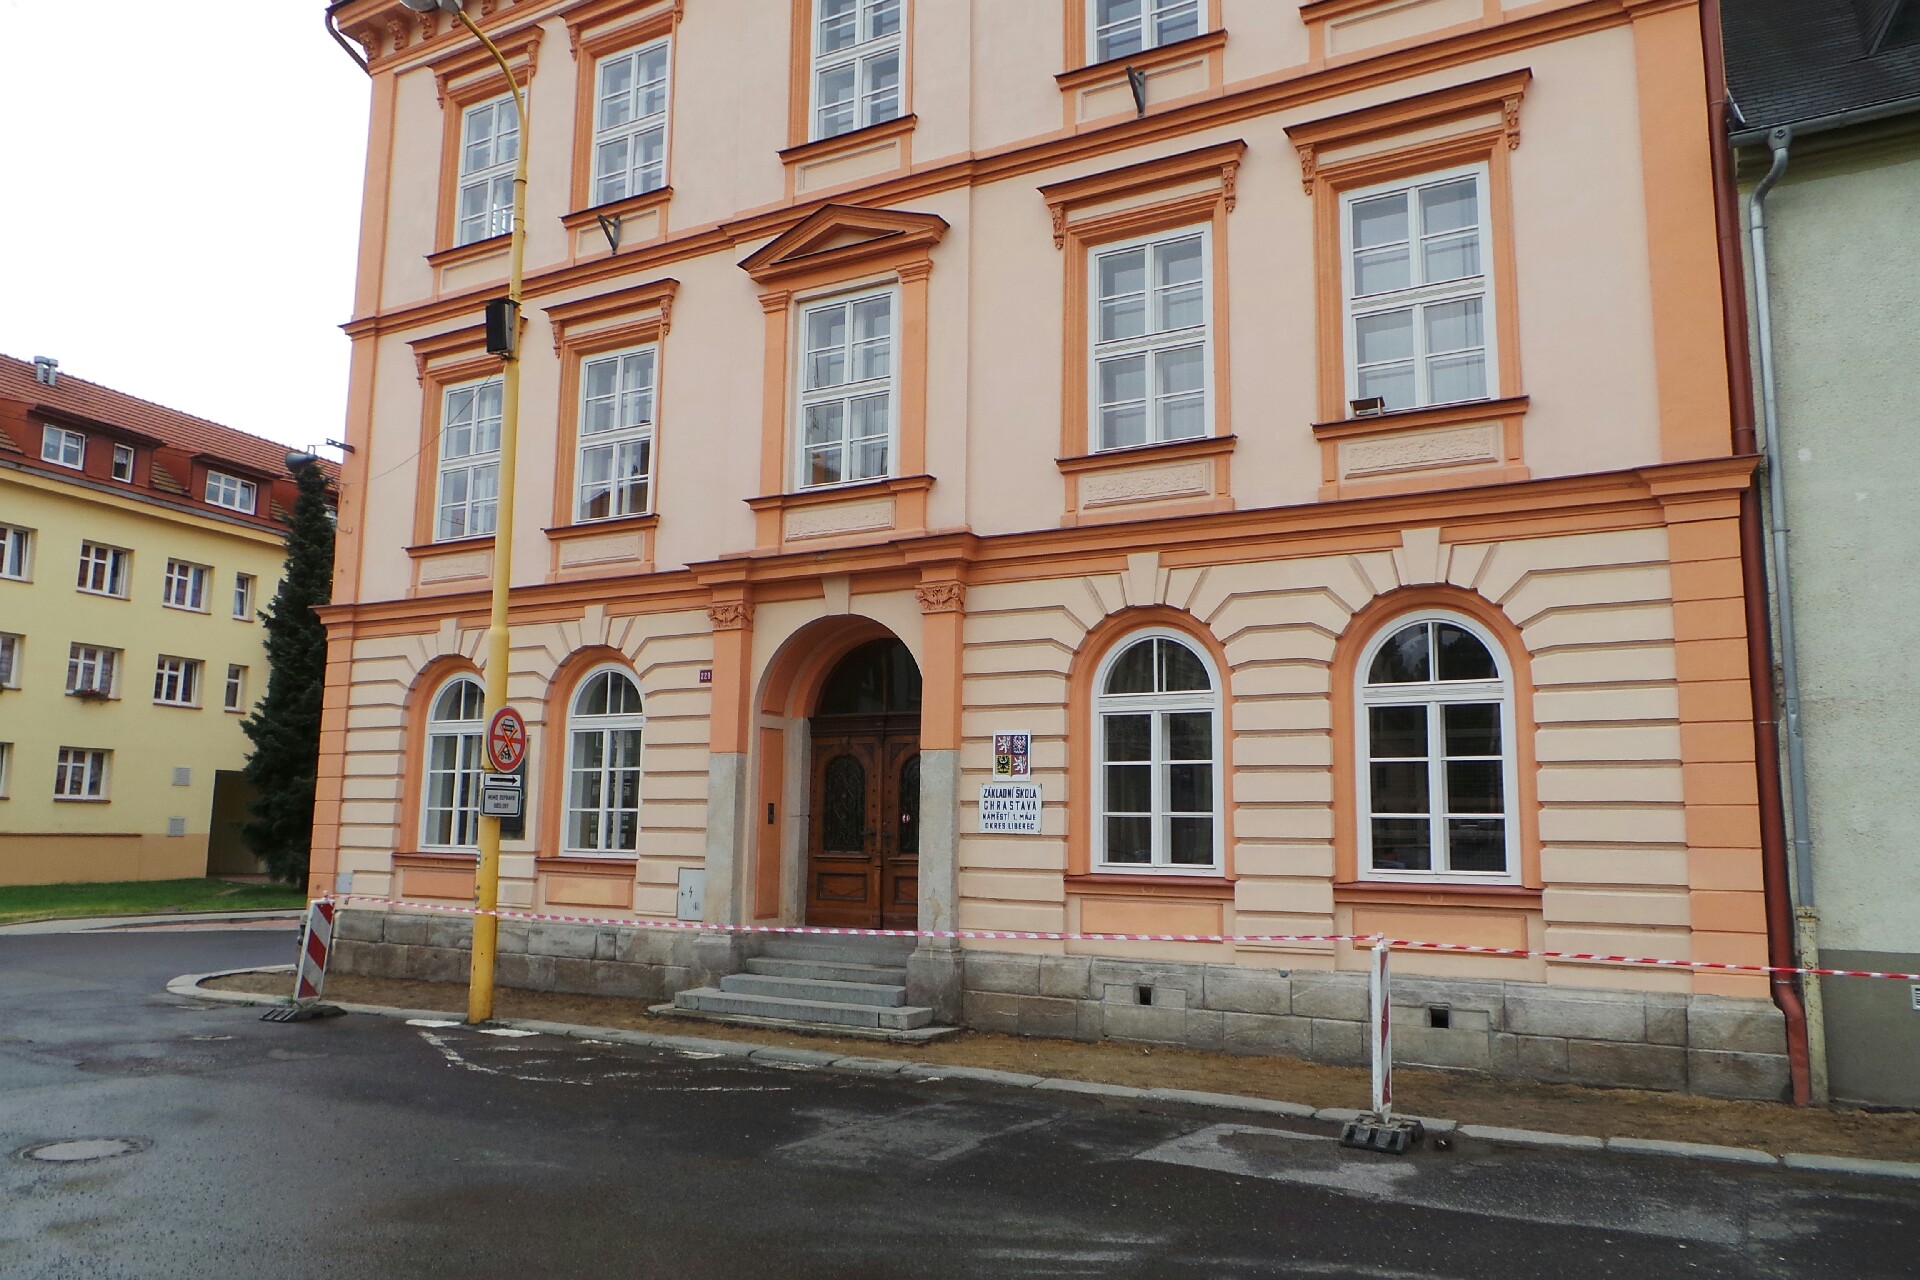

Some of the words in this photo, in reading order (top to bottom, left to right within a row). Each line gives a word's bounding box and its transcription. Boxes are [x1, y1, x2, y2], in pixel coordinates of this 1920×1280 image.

[983, 786, 1015, 798] ZÁKLADNÍ
[1015, 786, 1036, 798] ŠKOLA
[983, 801, 1036, 810] CHRASTAVA
[982, 811, 1010, 820] NÁMĚSTÍ
[1020, 811, 1036, 820] MÁJE
[1008, 822, 1035, 830] LIBEREC
